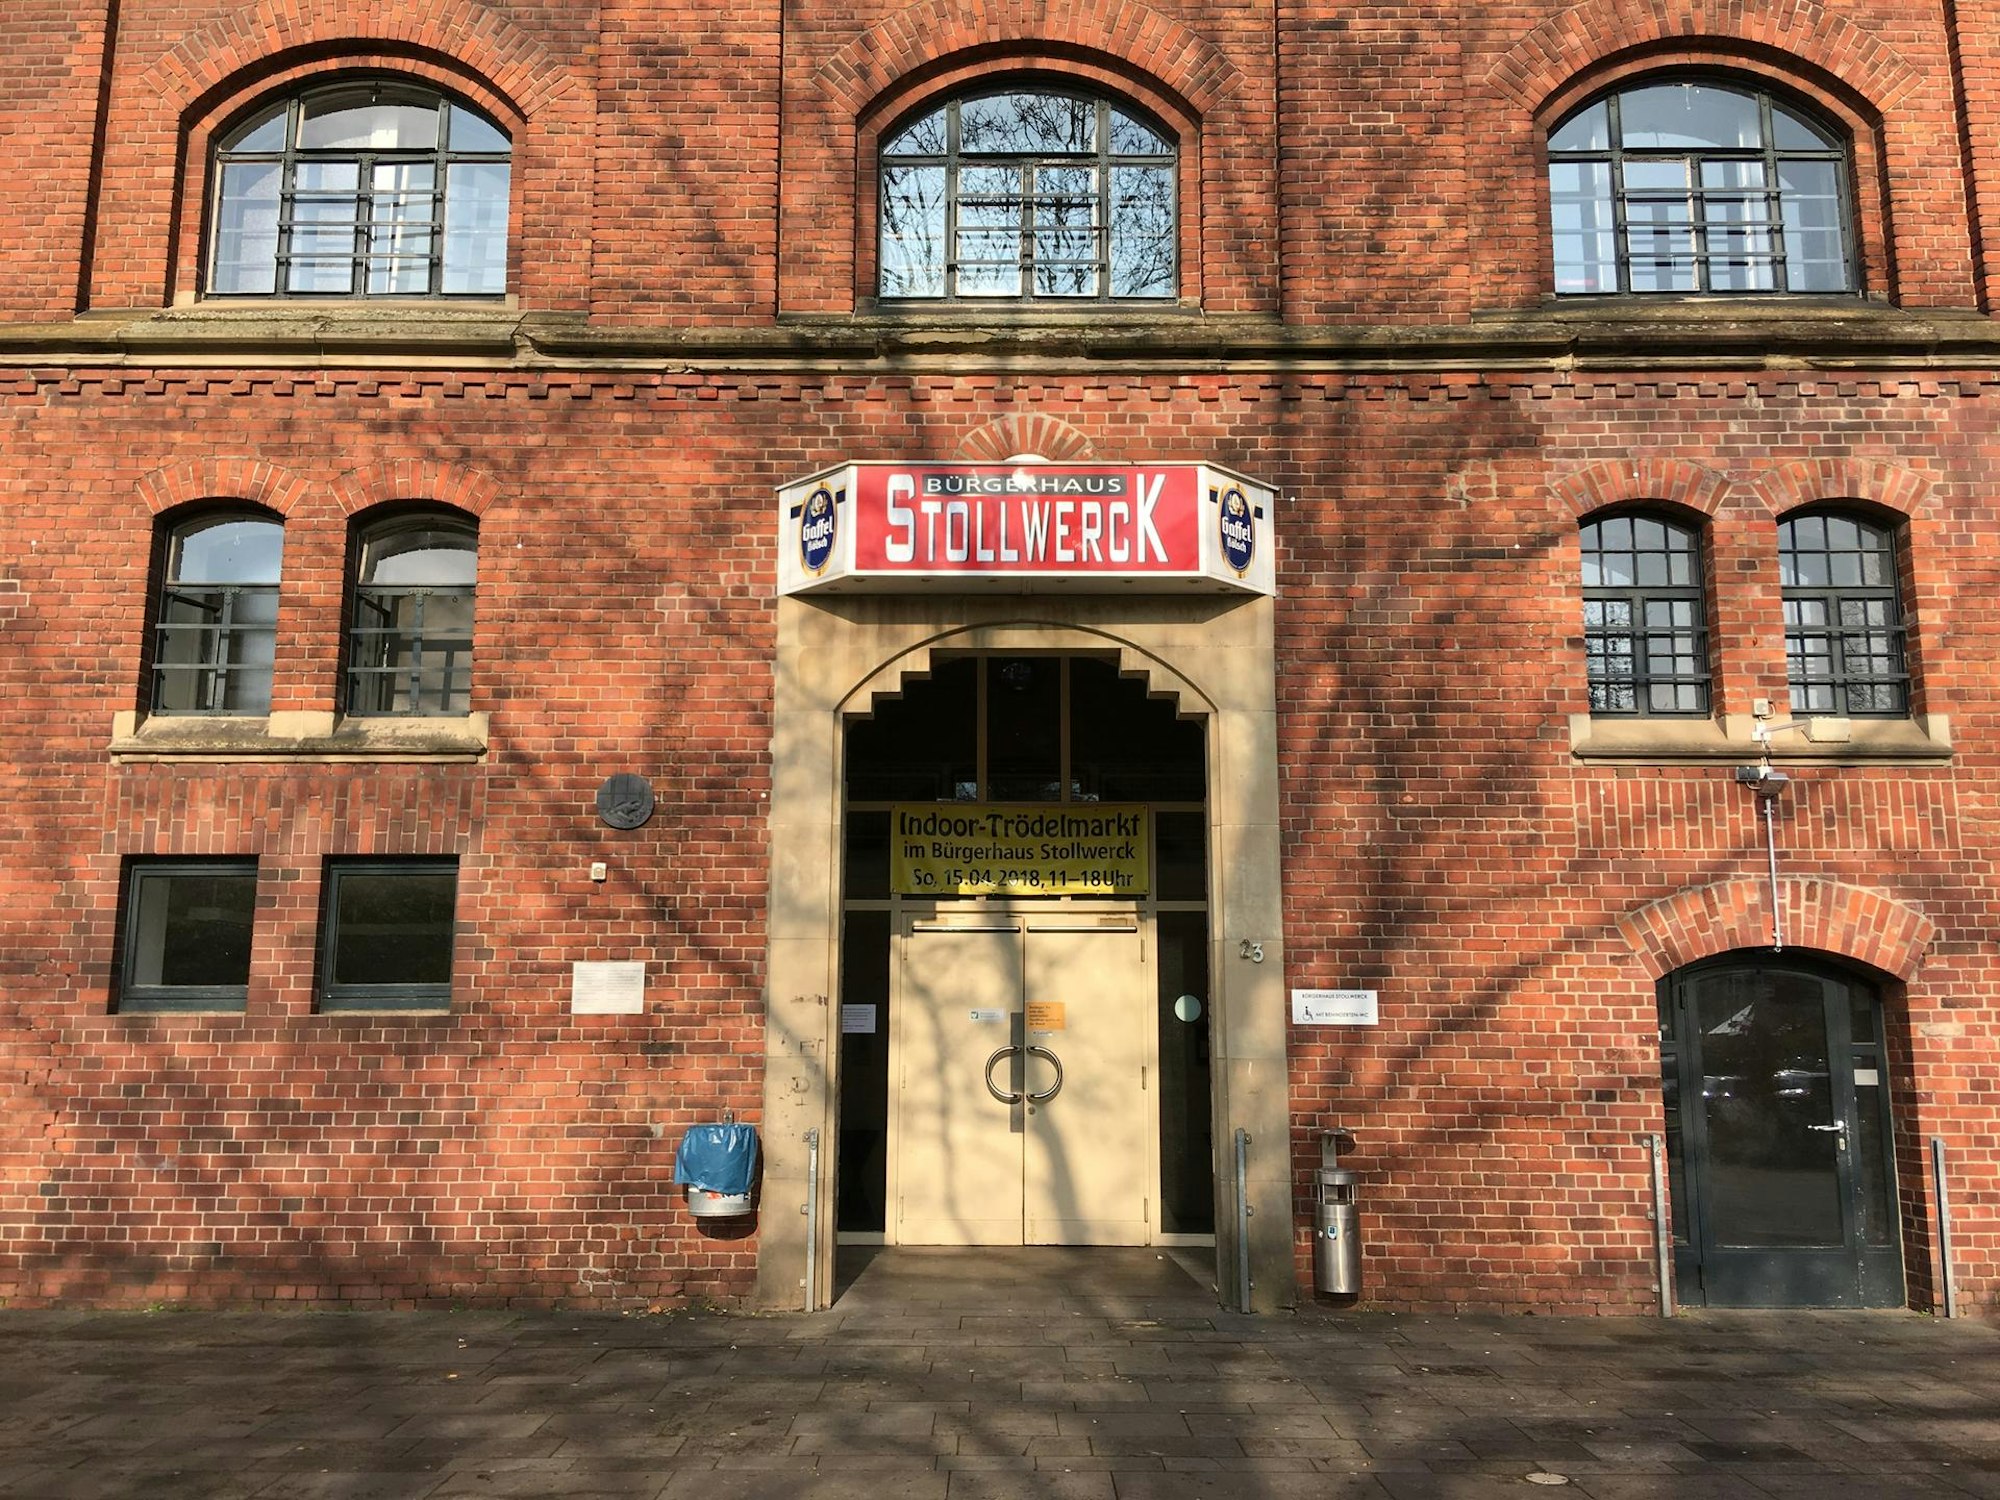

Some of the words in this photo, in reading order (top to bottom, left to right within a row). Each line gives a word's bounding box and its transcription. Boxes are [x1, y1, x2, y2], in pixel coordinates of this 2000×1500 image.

[927, 474, 1122, 494] BÜRGERHAUS
[802, 515, 834, 541] Gaffel
[885, 473, 1169, 564] STOLLWERCK
[1222, 515, 1252, 543] Gaffel
[900, 811, 1141, 838] Indoor-Trödelmarkt
[904, 841, 926, 859] im
[932, 841, 1034, 864] Bürgerhaus
[1041, 841, 1135, 861] Stollwerck
[1239, 938, 1265, 963] 23
